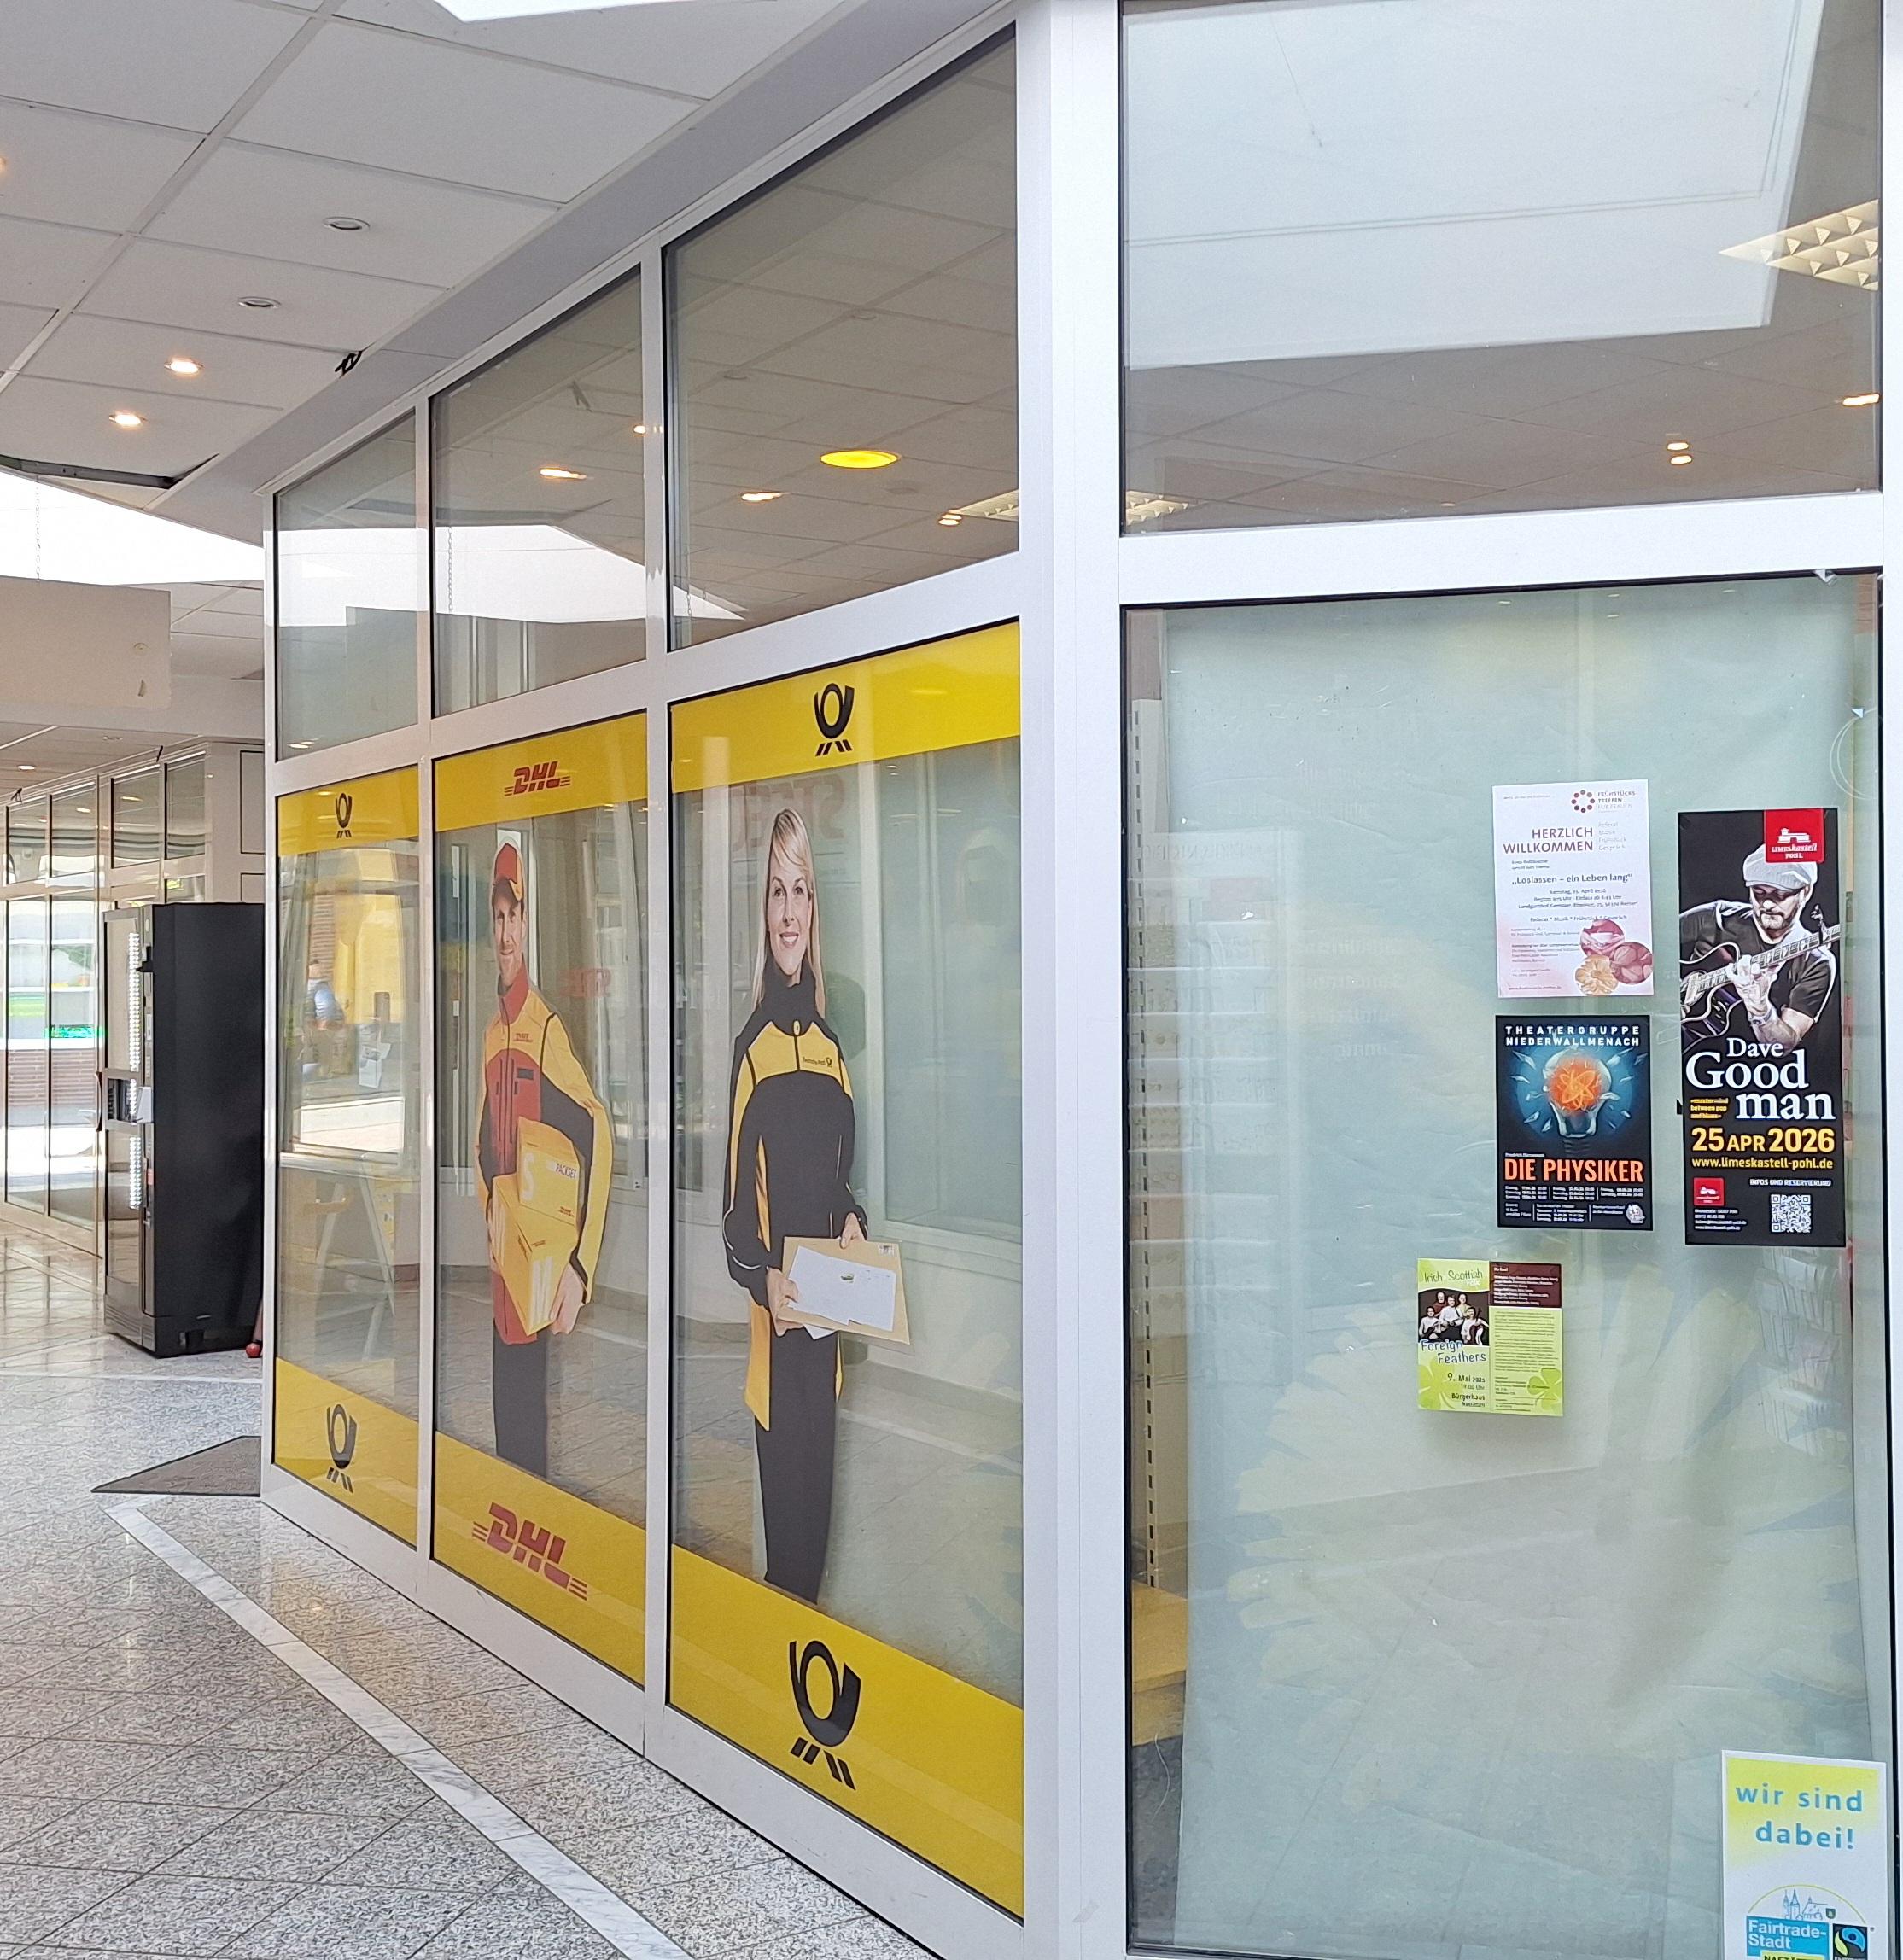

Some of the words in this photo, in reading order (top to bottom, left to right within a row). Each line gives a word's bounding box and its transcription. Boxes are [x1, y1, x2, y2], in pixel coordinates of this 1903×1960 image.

[513, 761, 560, 795] DHL
[1532, 826, 1593, 839] HERZLICH
[1503, 840, 1593, 854] WILLKOMMEN
[1512, 876, 1557, 885] „Loslassen
[1567, 874, 1579, 883] ein
[1505, 1026, 1639, 1035] THEATERGRUPPE
[1506, 1037, 1639, 1046] NIEDERWALLMENACH
[1726, 1037, 1783, 1058] Dave
[1685, 1049, 1809, 1088] Good
[1736, 1093, 1836, 1119] man
[1691, 1128, 1724, 1152] 25
[1726, 1135, 1765, 1152] APR
[1768, 1129, 1835, 1152] 2026
[556, 1163, 576, 1179] PACKSET
[1505, 1159, 1536, 1180] DIE
[1544, 1159, 1643, 1182] PHYSIKER
[1692, 1157, 1833, 1170] www.limeskastell-pohl.de
[522, 1152, 534, 1200] S
[1448, 1268, 1483, 1280] Scottish
[1421, 1339, 1462, 1352] Foreign
[1438, 1351, 1487, 1364] Feathers
[1447, 1373, 1456, 1381] 9.
[487, 1502, 571, 1590] DHL
[1736, 1782, 1783, 1805] wir
[1798, 1787, 1862, 1811] sind
[1755, 1820, 1854, 1850] dabei!
[1748, 1919, 1827, 1939] Fairtrade-
[1748, 1933, 1791, 1950] Stadt
